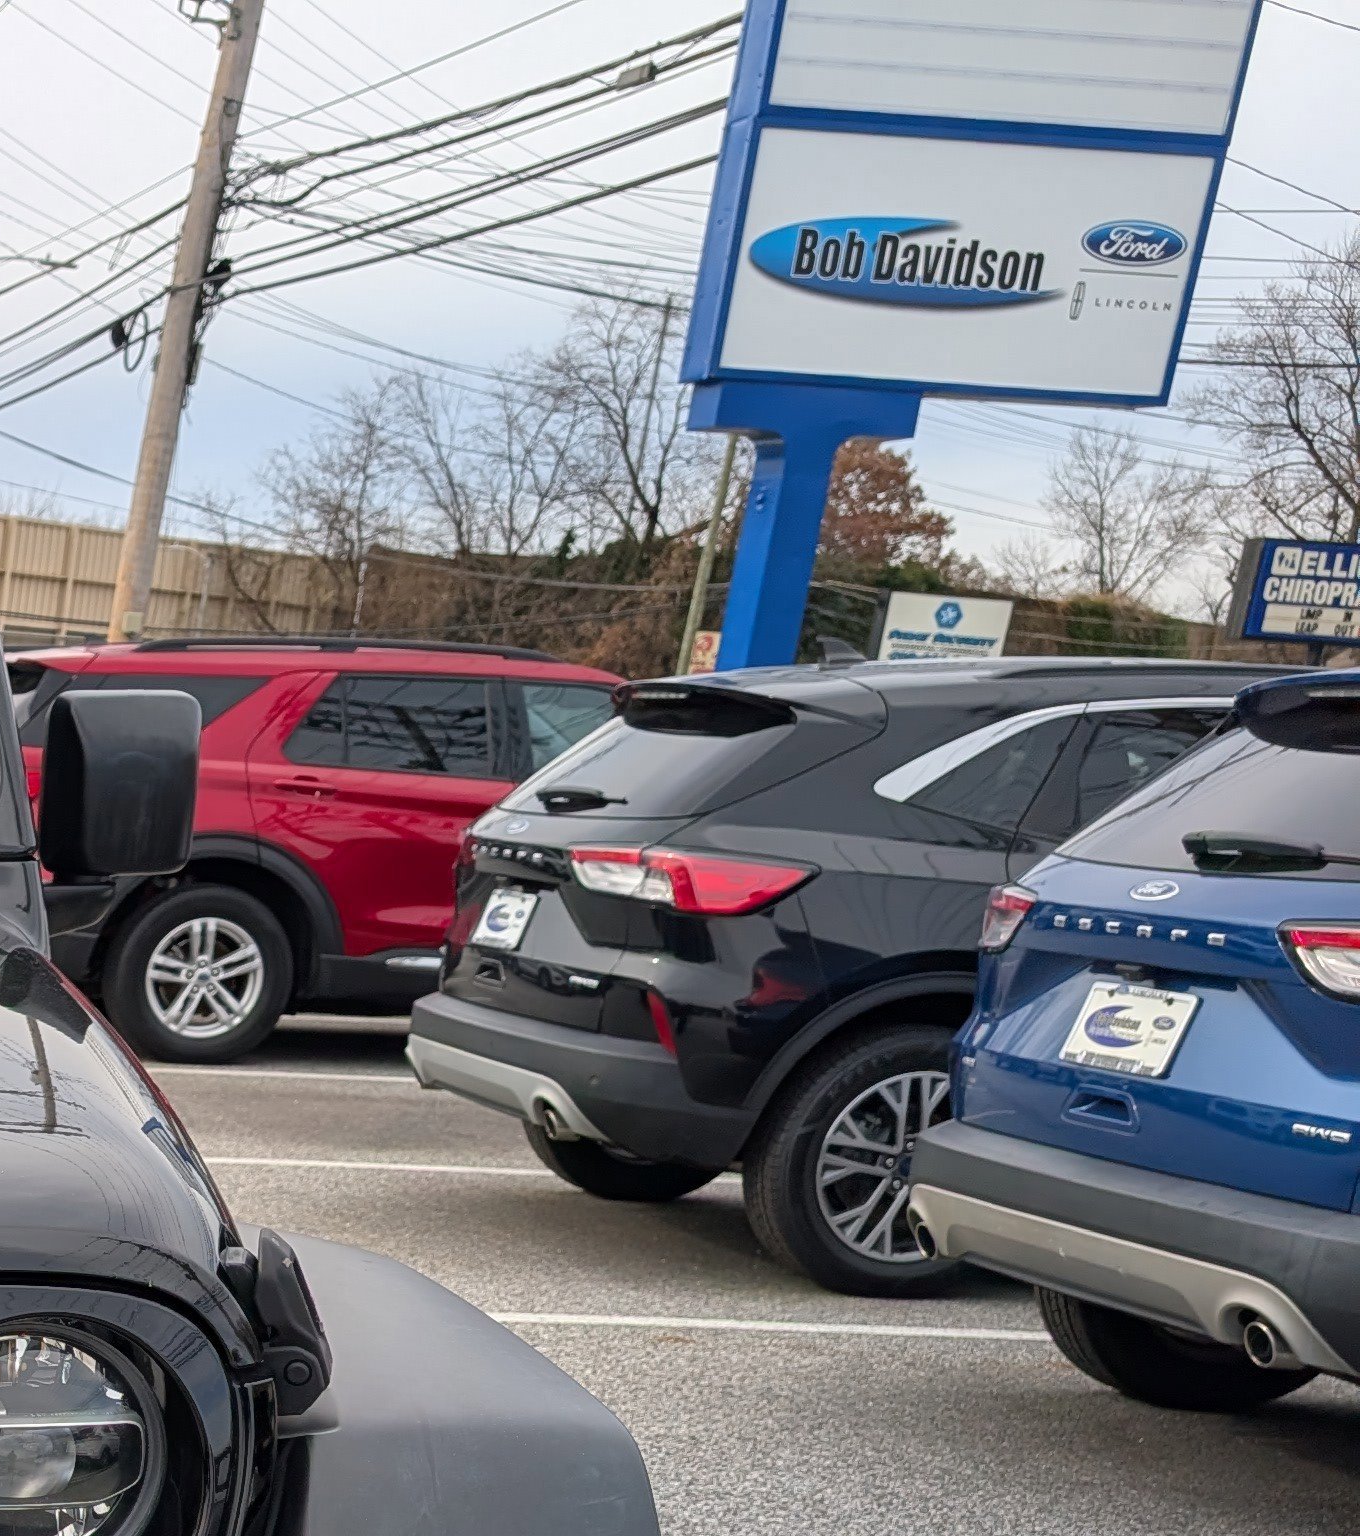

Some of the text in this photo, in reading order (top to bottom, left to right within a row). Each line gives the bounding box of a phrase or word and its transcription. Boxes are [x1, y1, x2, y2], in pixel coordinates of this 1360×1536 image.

[1099, 225, 1166, 259] Ford
[792, 227, 1046, 292] Bob Davidson
[1093, 297, 1173, 312] LINCOLN
[1262, 576, 1360, 608] CHIROPRA
